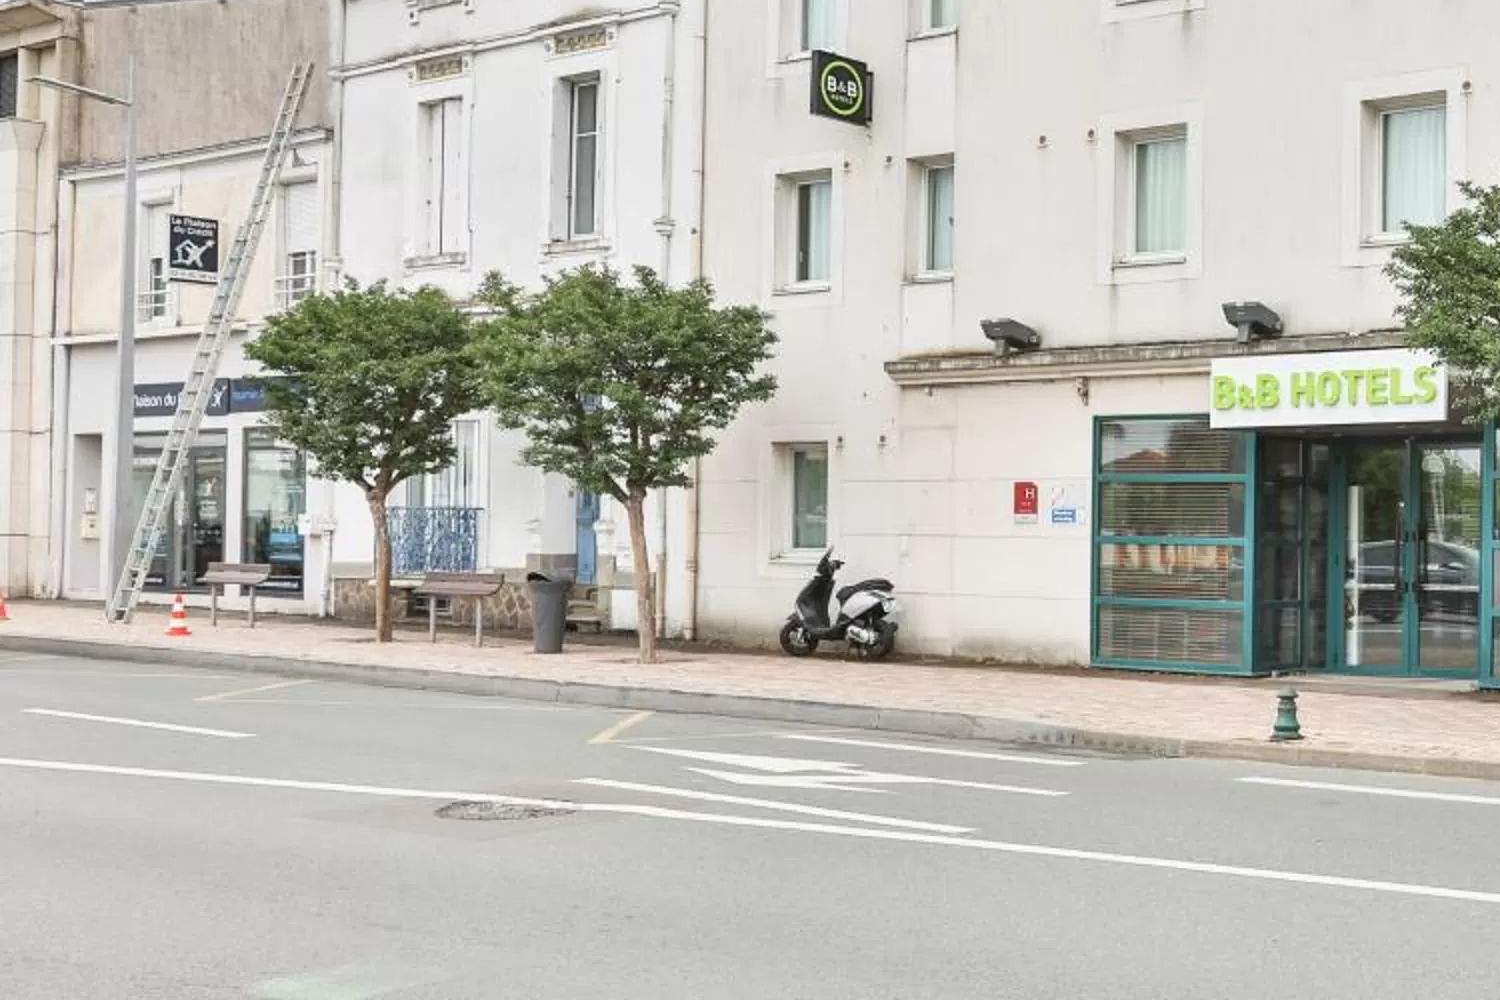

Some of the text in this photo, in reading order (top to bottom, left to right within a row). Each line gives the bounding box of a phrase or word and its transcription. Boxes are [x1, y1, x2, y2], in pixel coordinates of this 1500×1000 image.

[827, 75, 857, 98] B&B
[1213, 366, 1438, 411] B&B HOTELS
[1025, 487, 1035, 499] H
